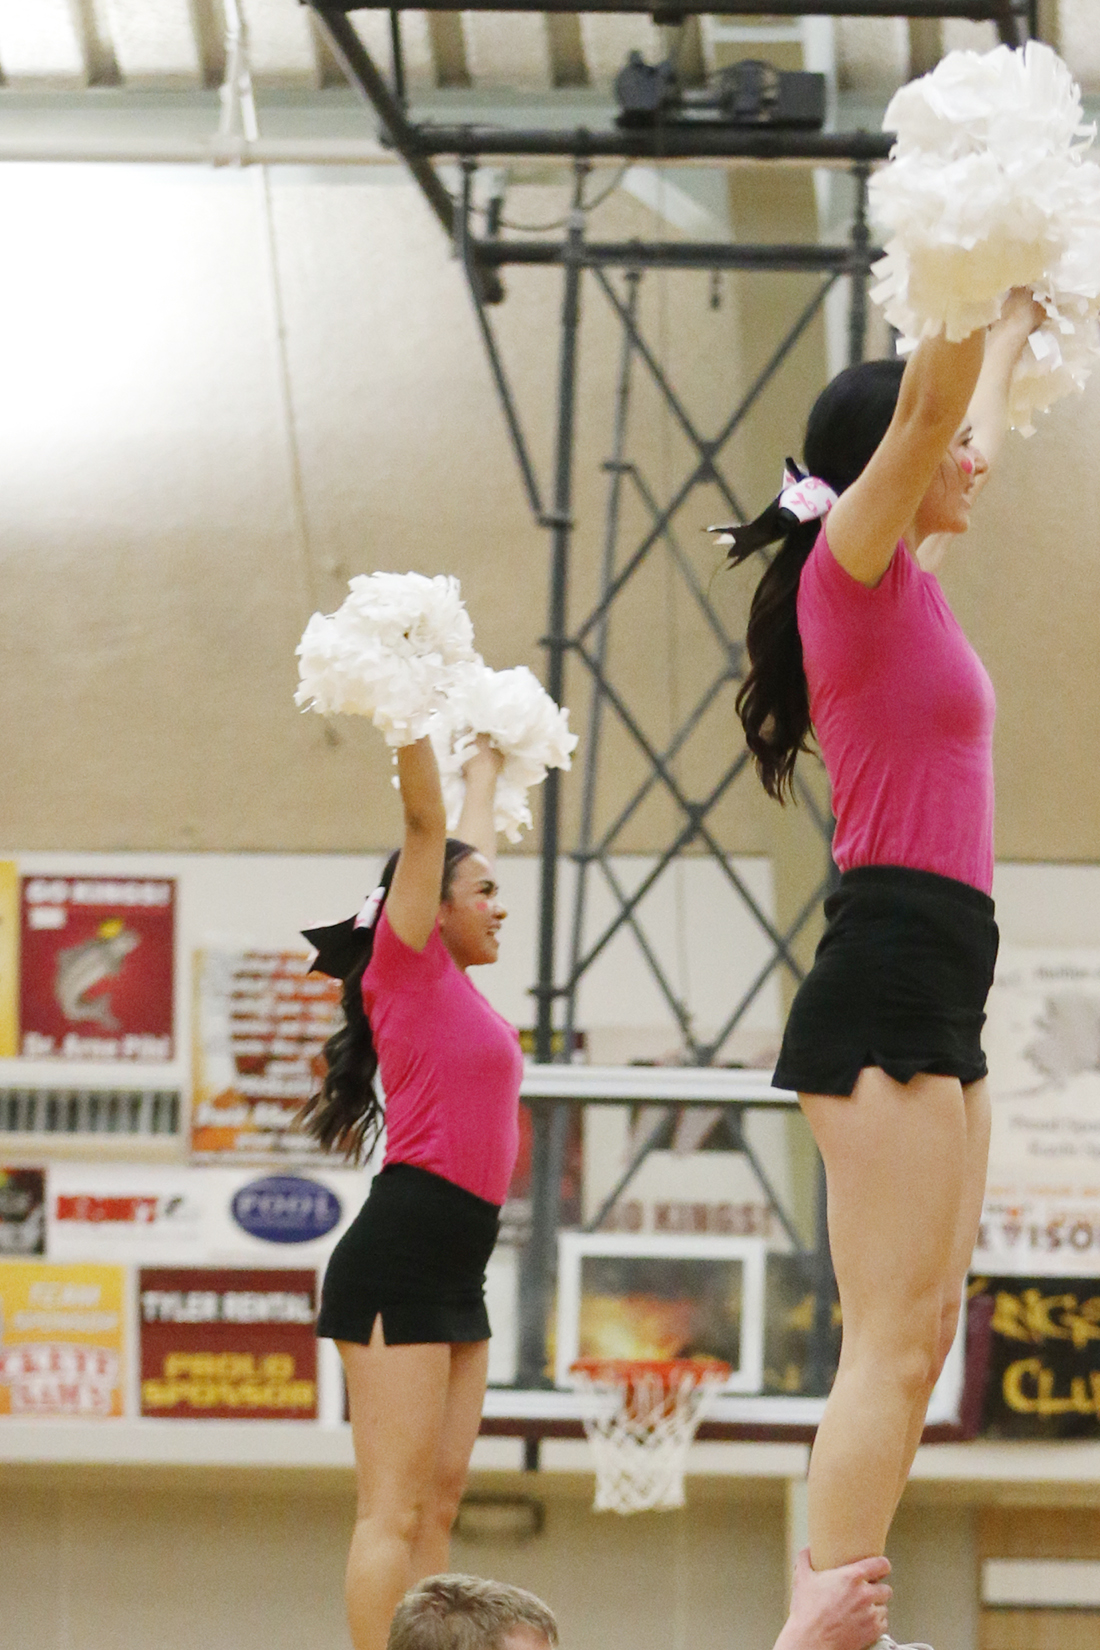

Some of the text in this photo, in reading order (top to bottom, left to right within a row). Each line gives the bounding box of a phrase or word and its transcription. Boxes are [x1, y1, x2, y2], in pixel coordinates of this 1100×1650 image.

[142, 1290, 315, 1325] TYLER RENTAL
[142, 1378, 316, 1408] SPONSOR
